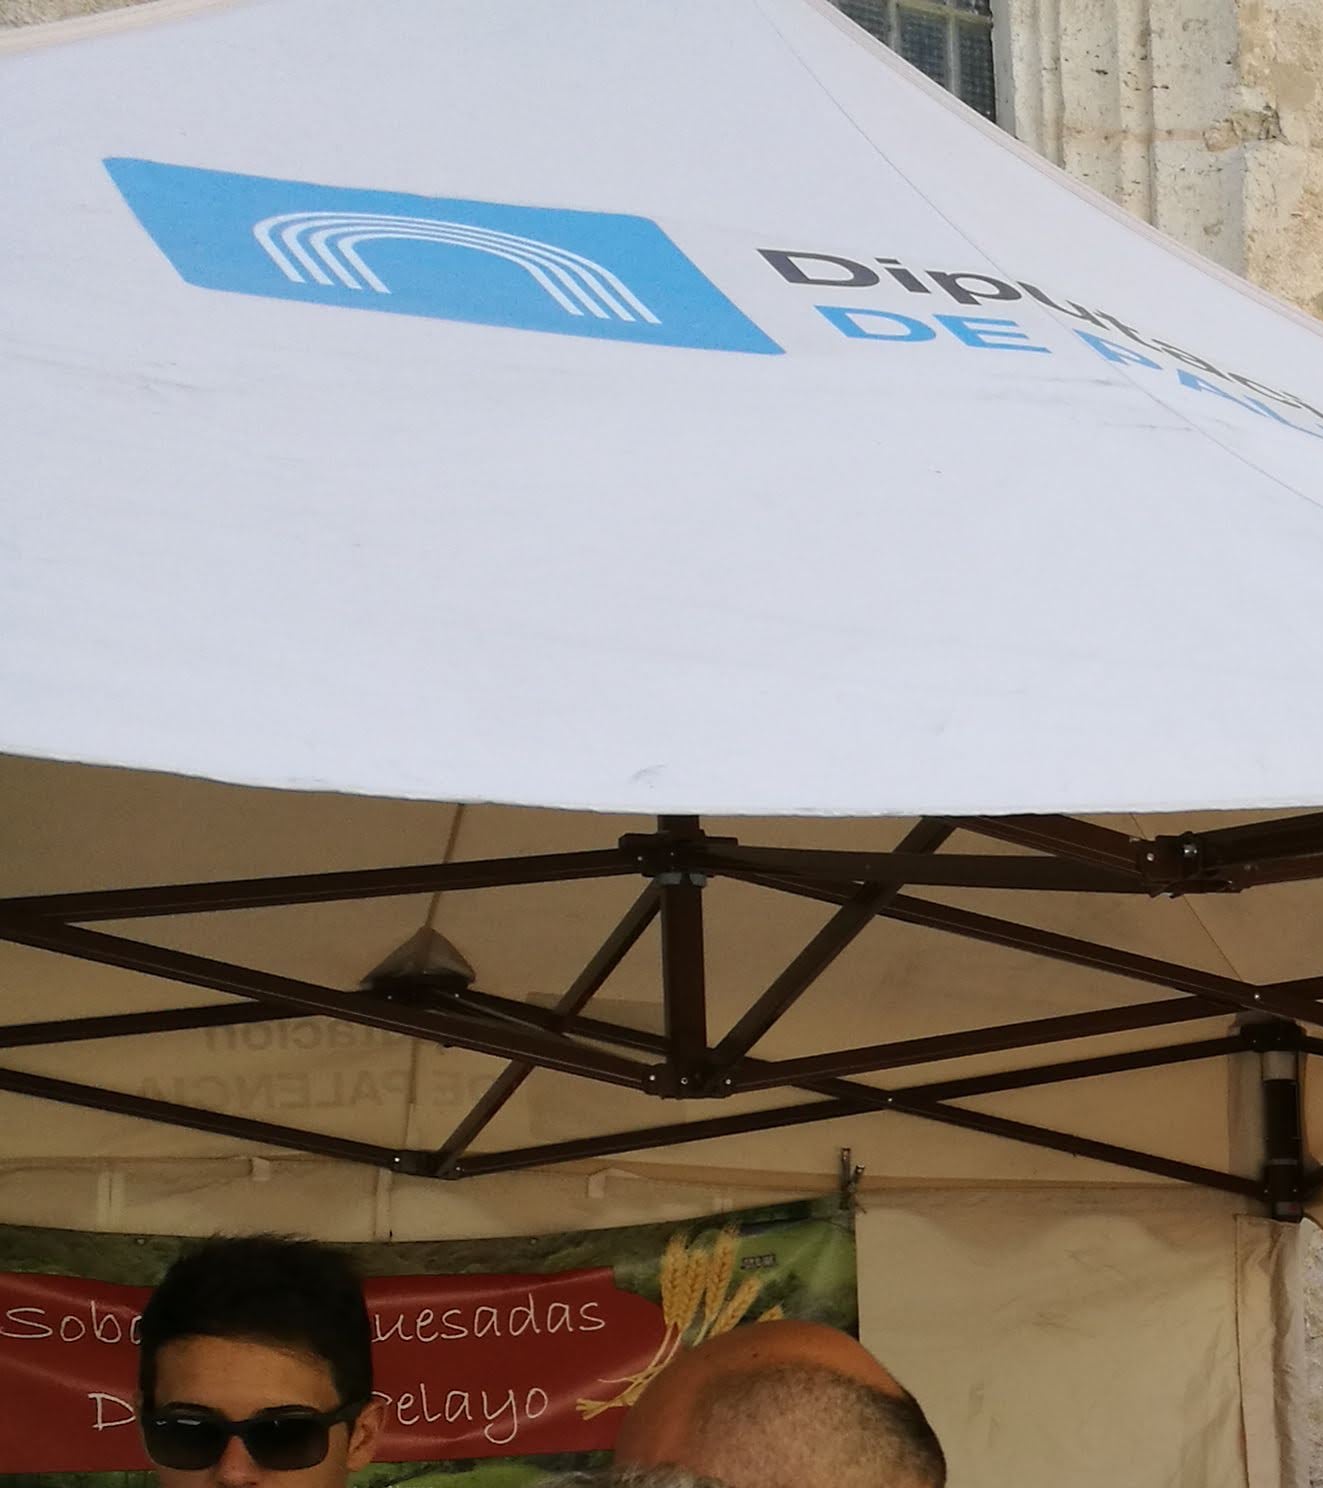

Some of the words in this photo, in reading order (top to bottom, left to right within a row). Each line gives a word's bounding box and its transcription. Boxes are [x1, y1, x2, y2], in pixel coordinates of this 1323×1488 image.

[813, 304, 1053, 354] DE
[371, 1292, 607, 1343] uesadas
[88, 1392, 137, 1432] D
